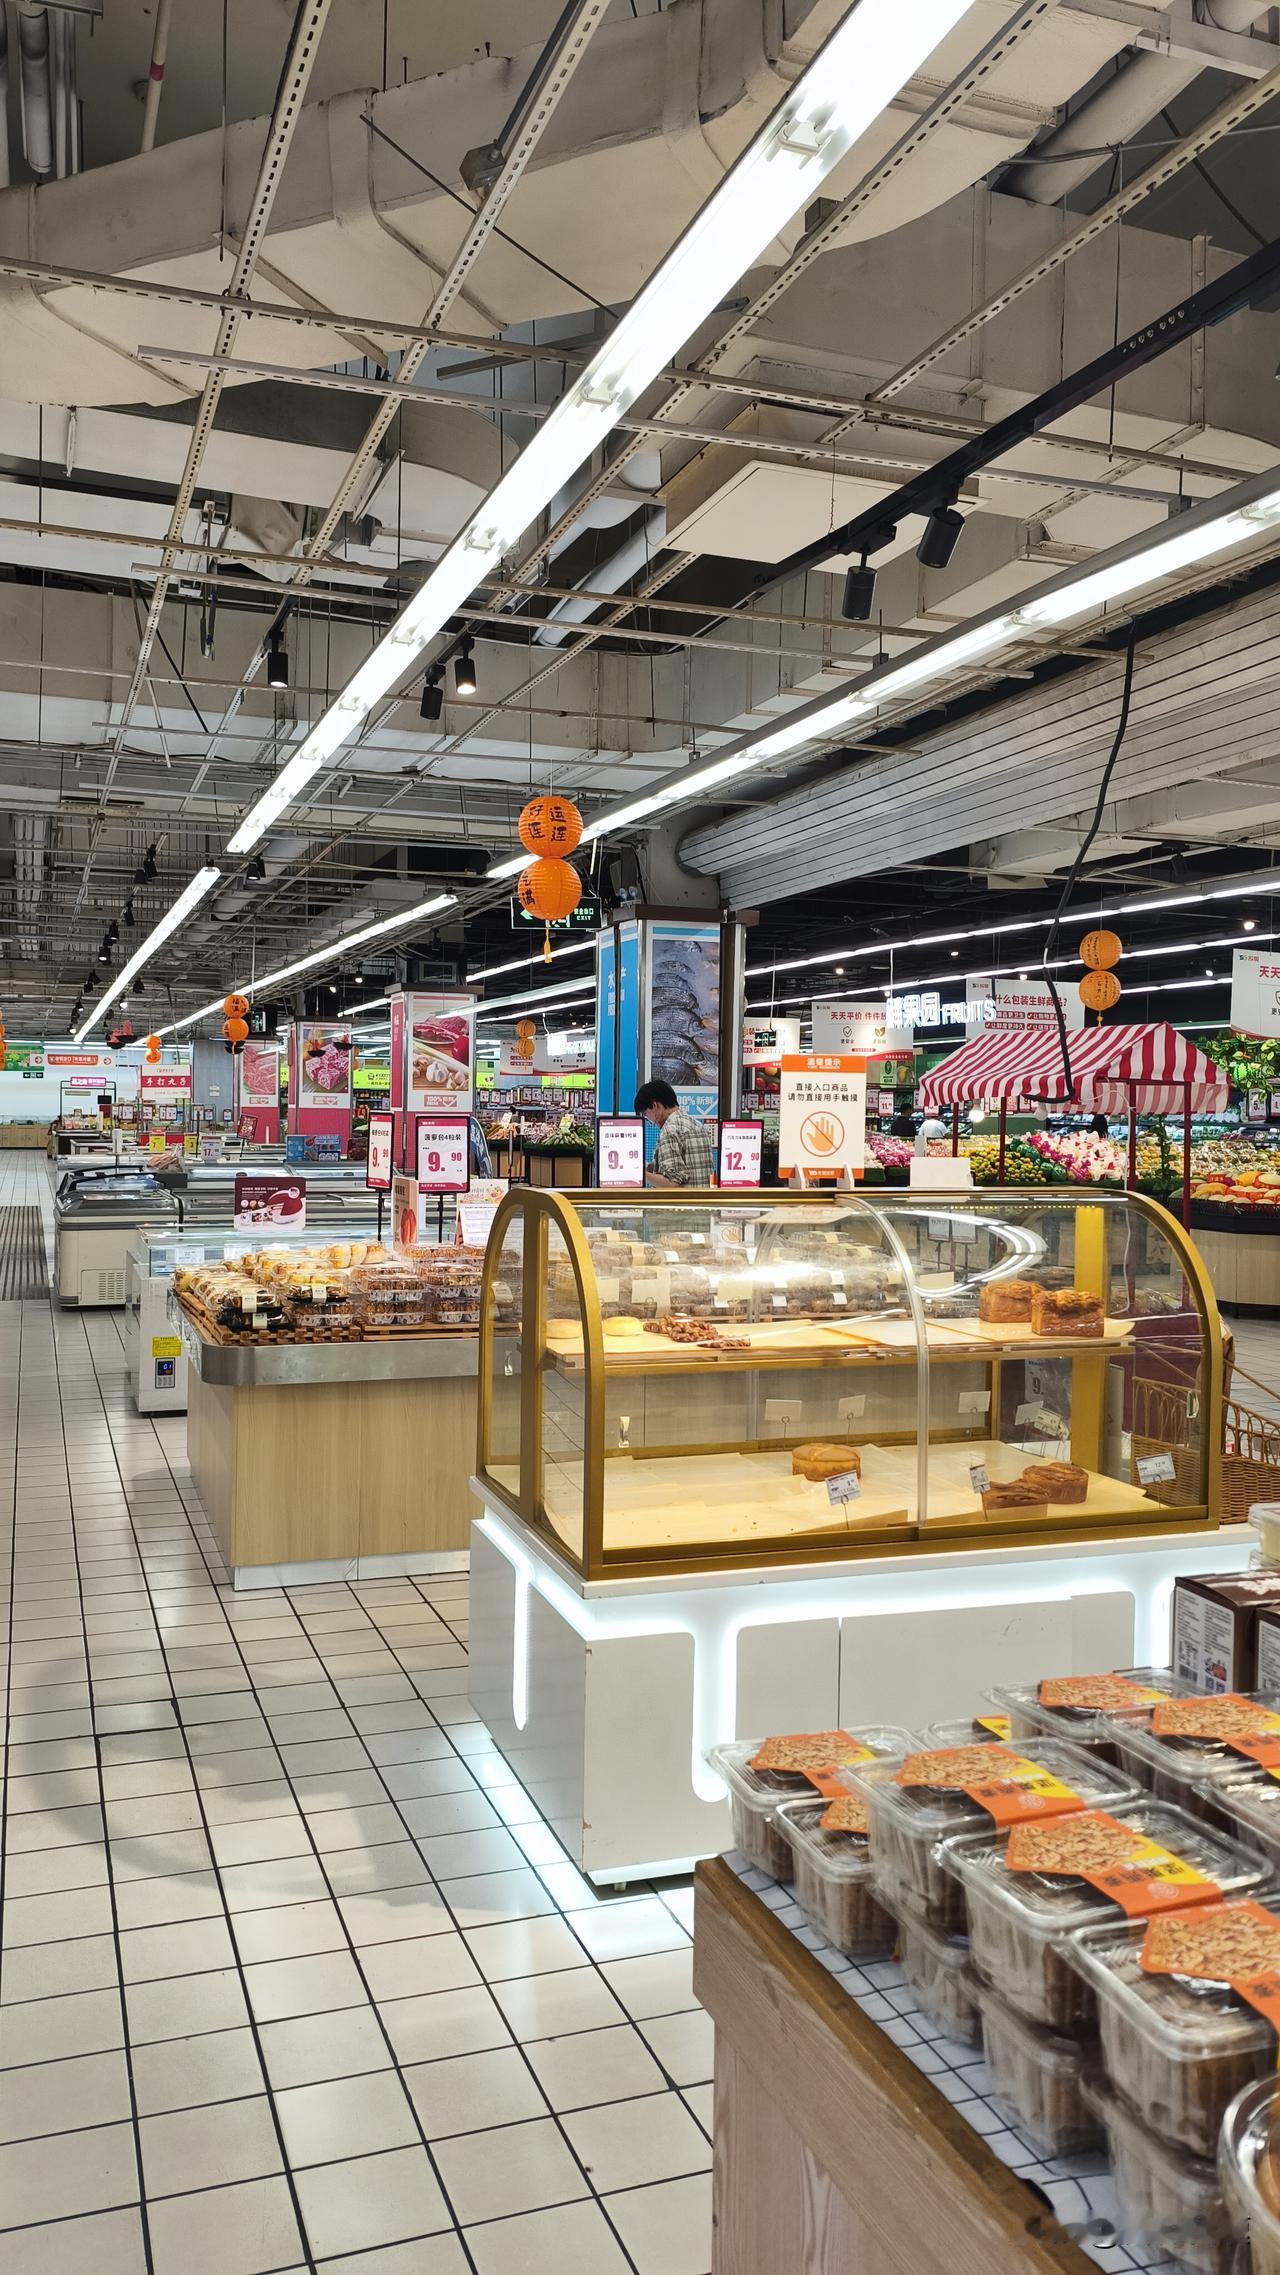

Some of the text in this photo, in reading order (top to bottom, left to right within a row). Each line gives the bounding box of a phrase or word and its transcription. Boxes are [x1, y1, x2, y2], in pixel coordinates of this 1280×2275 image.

[831, 1011, 862, 1021] 天天平价
[942, 999, 997, 1025] FRUITS
[796, 1082, 849, 1092] 直接入口商品
[787, 1093, 858, 1102] 请勿直接用手触摸
[451, 1152, 463, 1162] 90
[628, 1150, 639, 1159] 90
